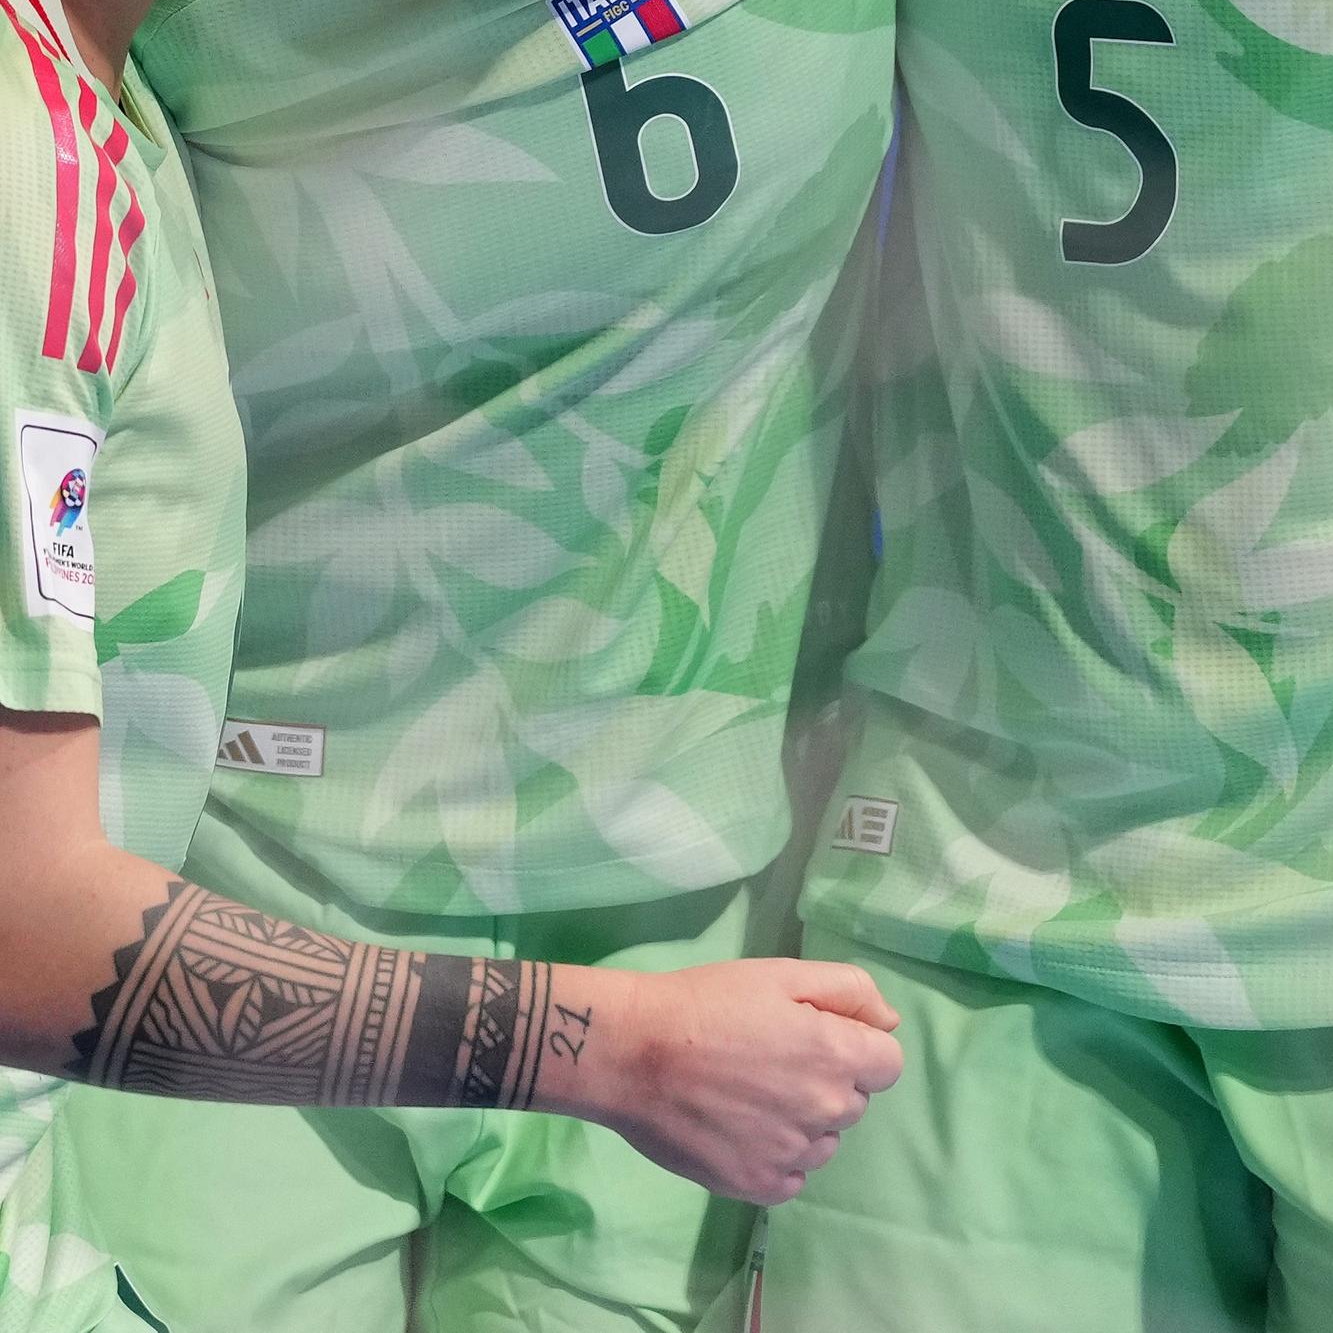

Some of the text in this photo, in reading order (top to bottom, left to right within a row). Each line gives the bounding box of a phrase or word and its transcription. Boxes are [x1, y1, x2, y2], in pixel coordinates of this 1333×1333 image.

[602, 0, 630, 24] FIGC
[579, 57, 741, 237] 6
[52, 541, 75, 558] FIFA
[71, 561, 94, 572] WORLD
[549, 1003, 592, 1066] 21
